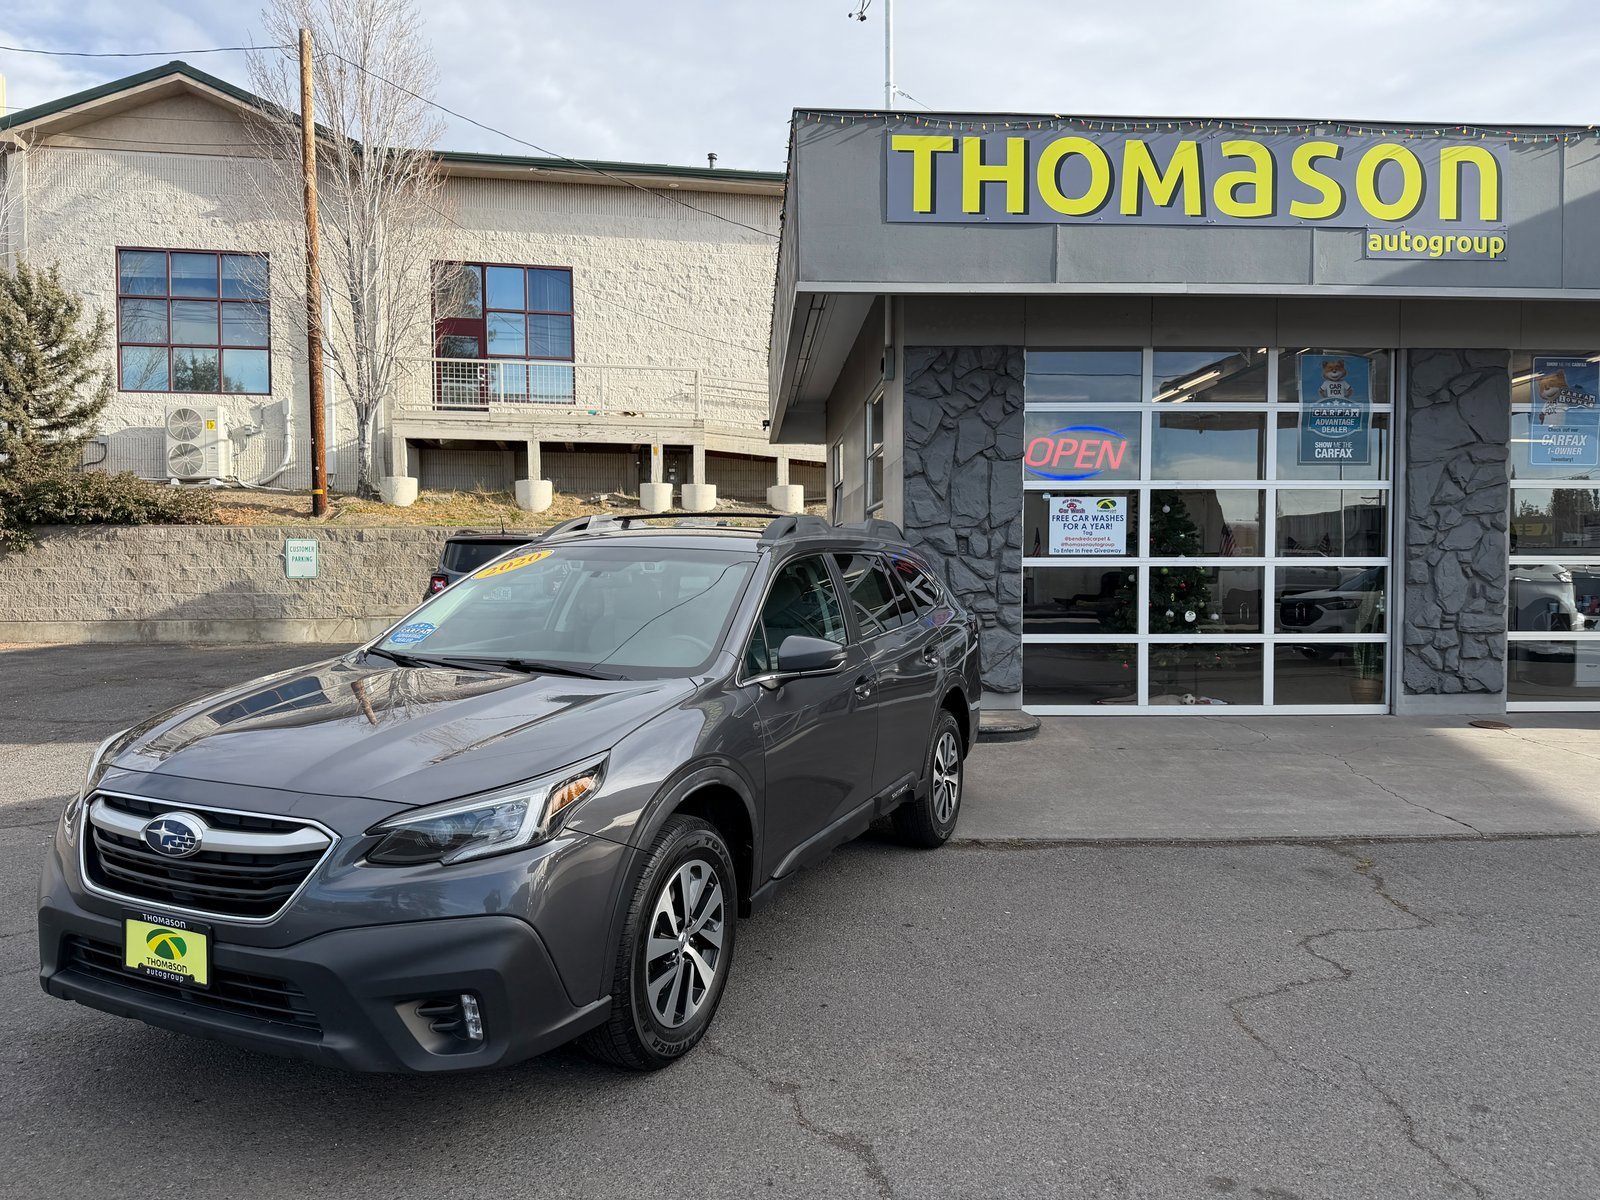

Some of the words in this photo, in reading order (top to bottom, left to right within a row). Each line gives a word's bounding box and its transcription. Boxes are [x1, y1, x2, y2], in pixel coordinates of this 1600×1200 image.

[1367, 230, 1506, 259] autogroup
[1313, 408, 1360, 417] CARFAX
[1542, 434, 1588, 446] CARFAX
[1025, 437, 1127, 470] OPEN
[1314, 448, 1354, 458] CARFAX
[485, 554, 542, 576] 2020
[146, 968, 184, 983] autogroup
